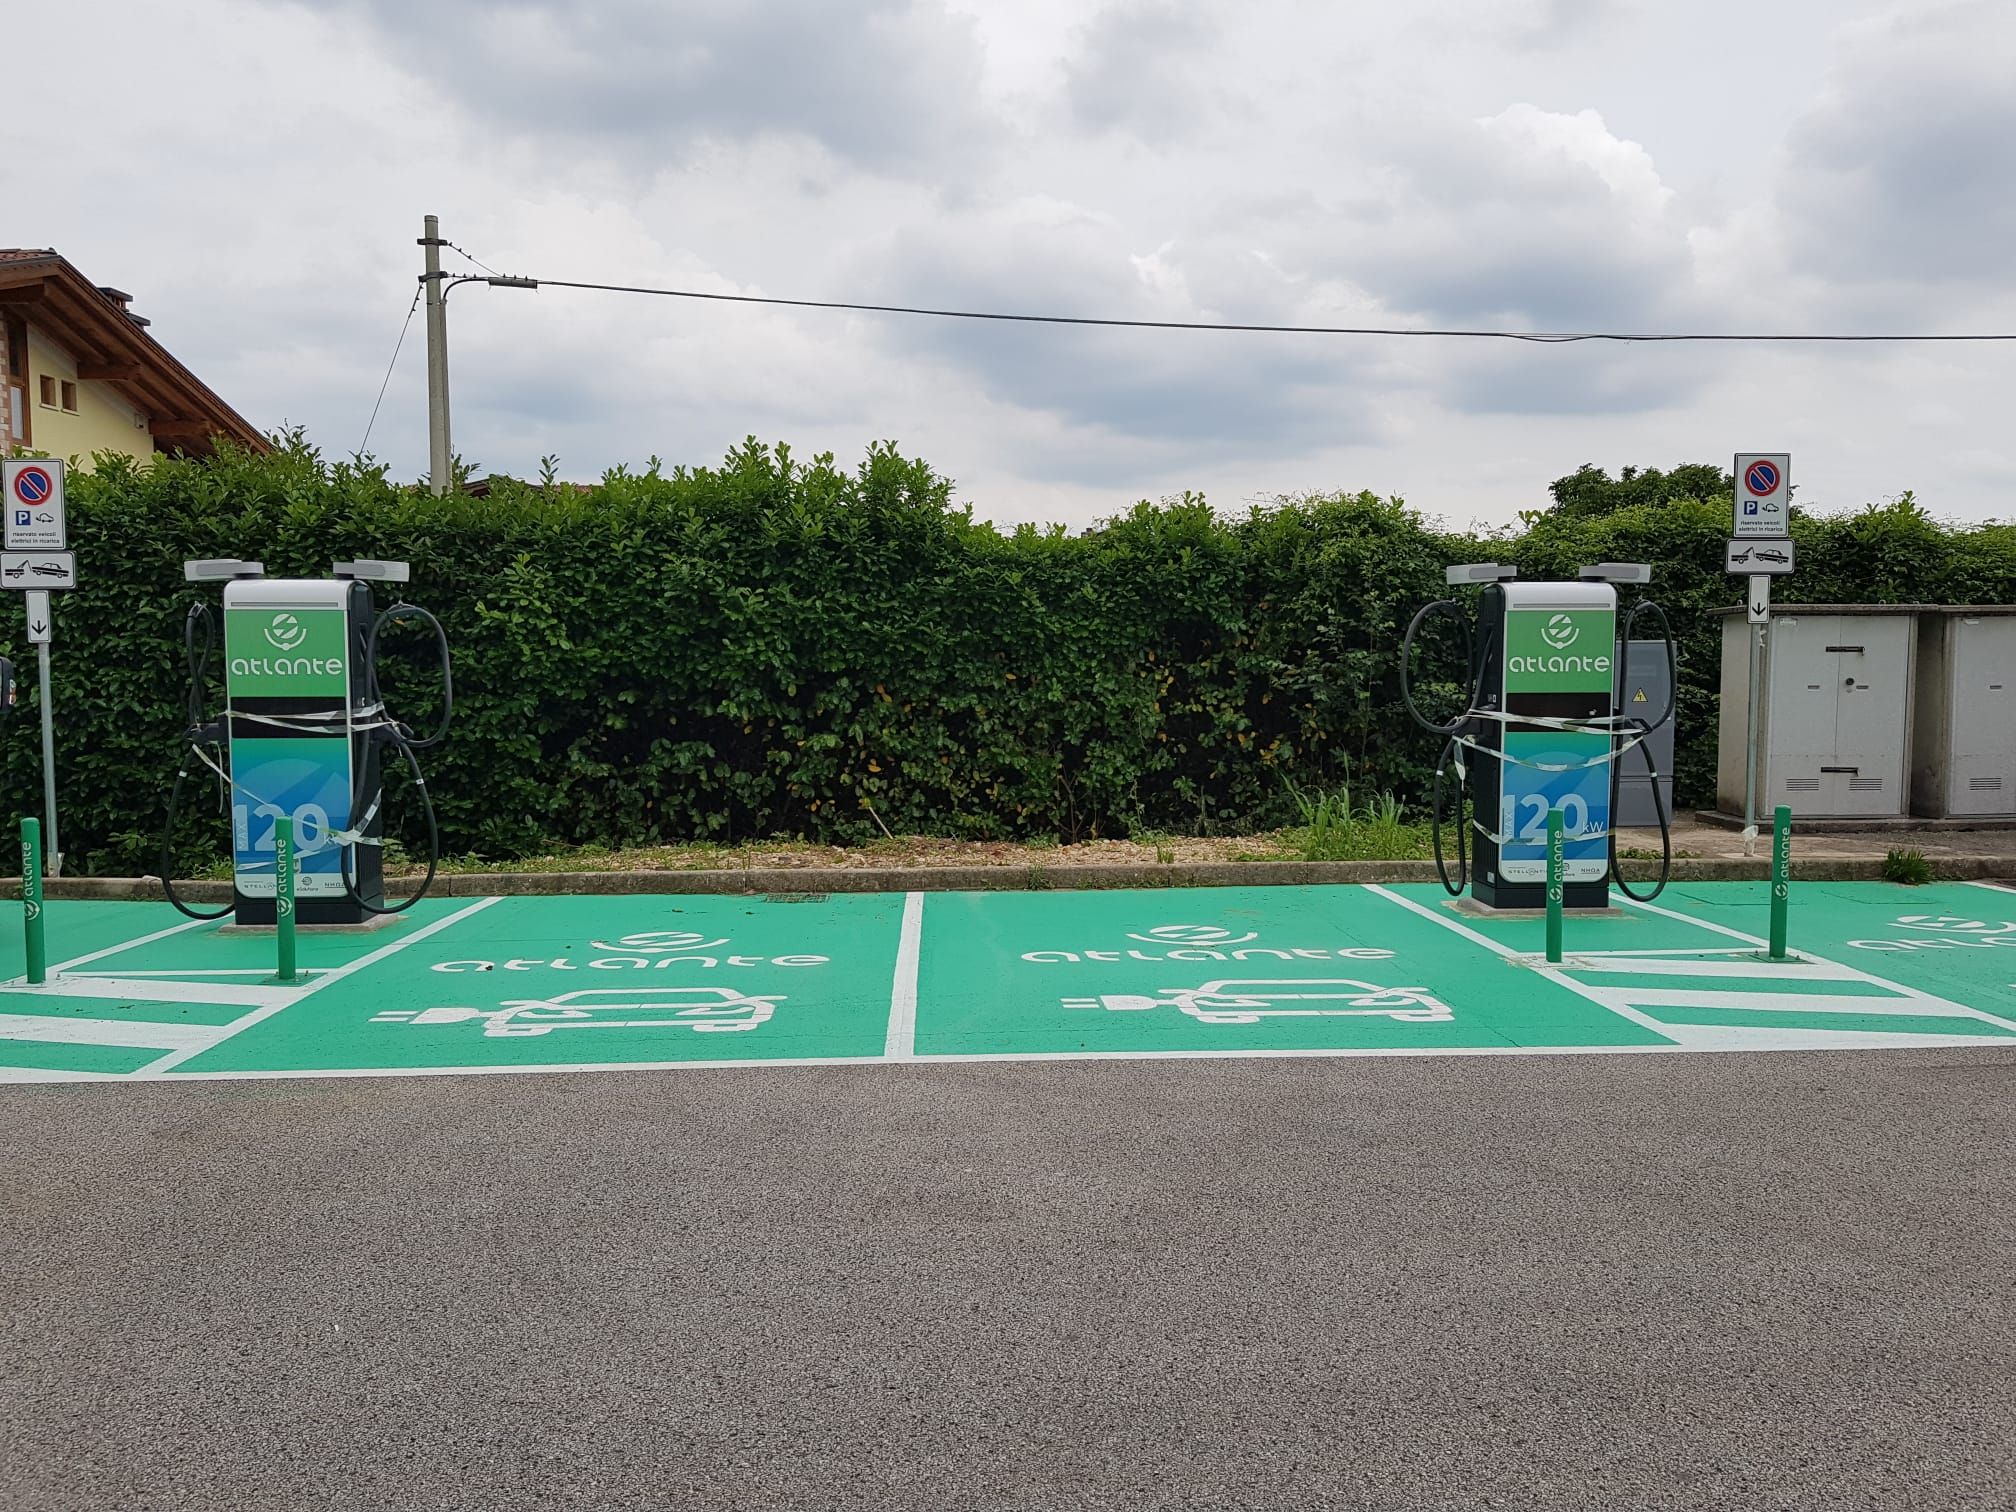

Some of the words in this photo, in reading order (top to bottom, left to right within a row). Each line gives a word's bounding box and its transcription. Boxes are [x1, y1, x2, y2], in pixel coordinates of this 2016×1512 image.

[18, 511, 28, 524] P
[1746, 502, 1756, 514] P
[231, 658, 342, 675] atlante
[1509, 656, 1610, 672] atlante
[233, 803, 329, 852] 120
[1503, 793, 1588, 841] 120
[1582, 821, 1604, 833] kW
[1504, 813, 1513, 837] MAX
[1554, 830, 1563, 881] atlante
[1781, 827, 1791, 877] atlante
[23, 841, 33, 896] atlante
[277, 839, 288, 893] atlante
[430, 954, 830, 973] atlante
[1021, 948, 1396, 962] atlante
